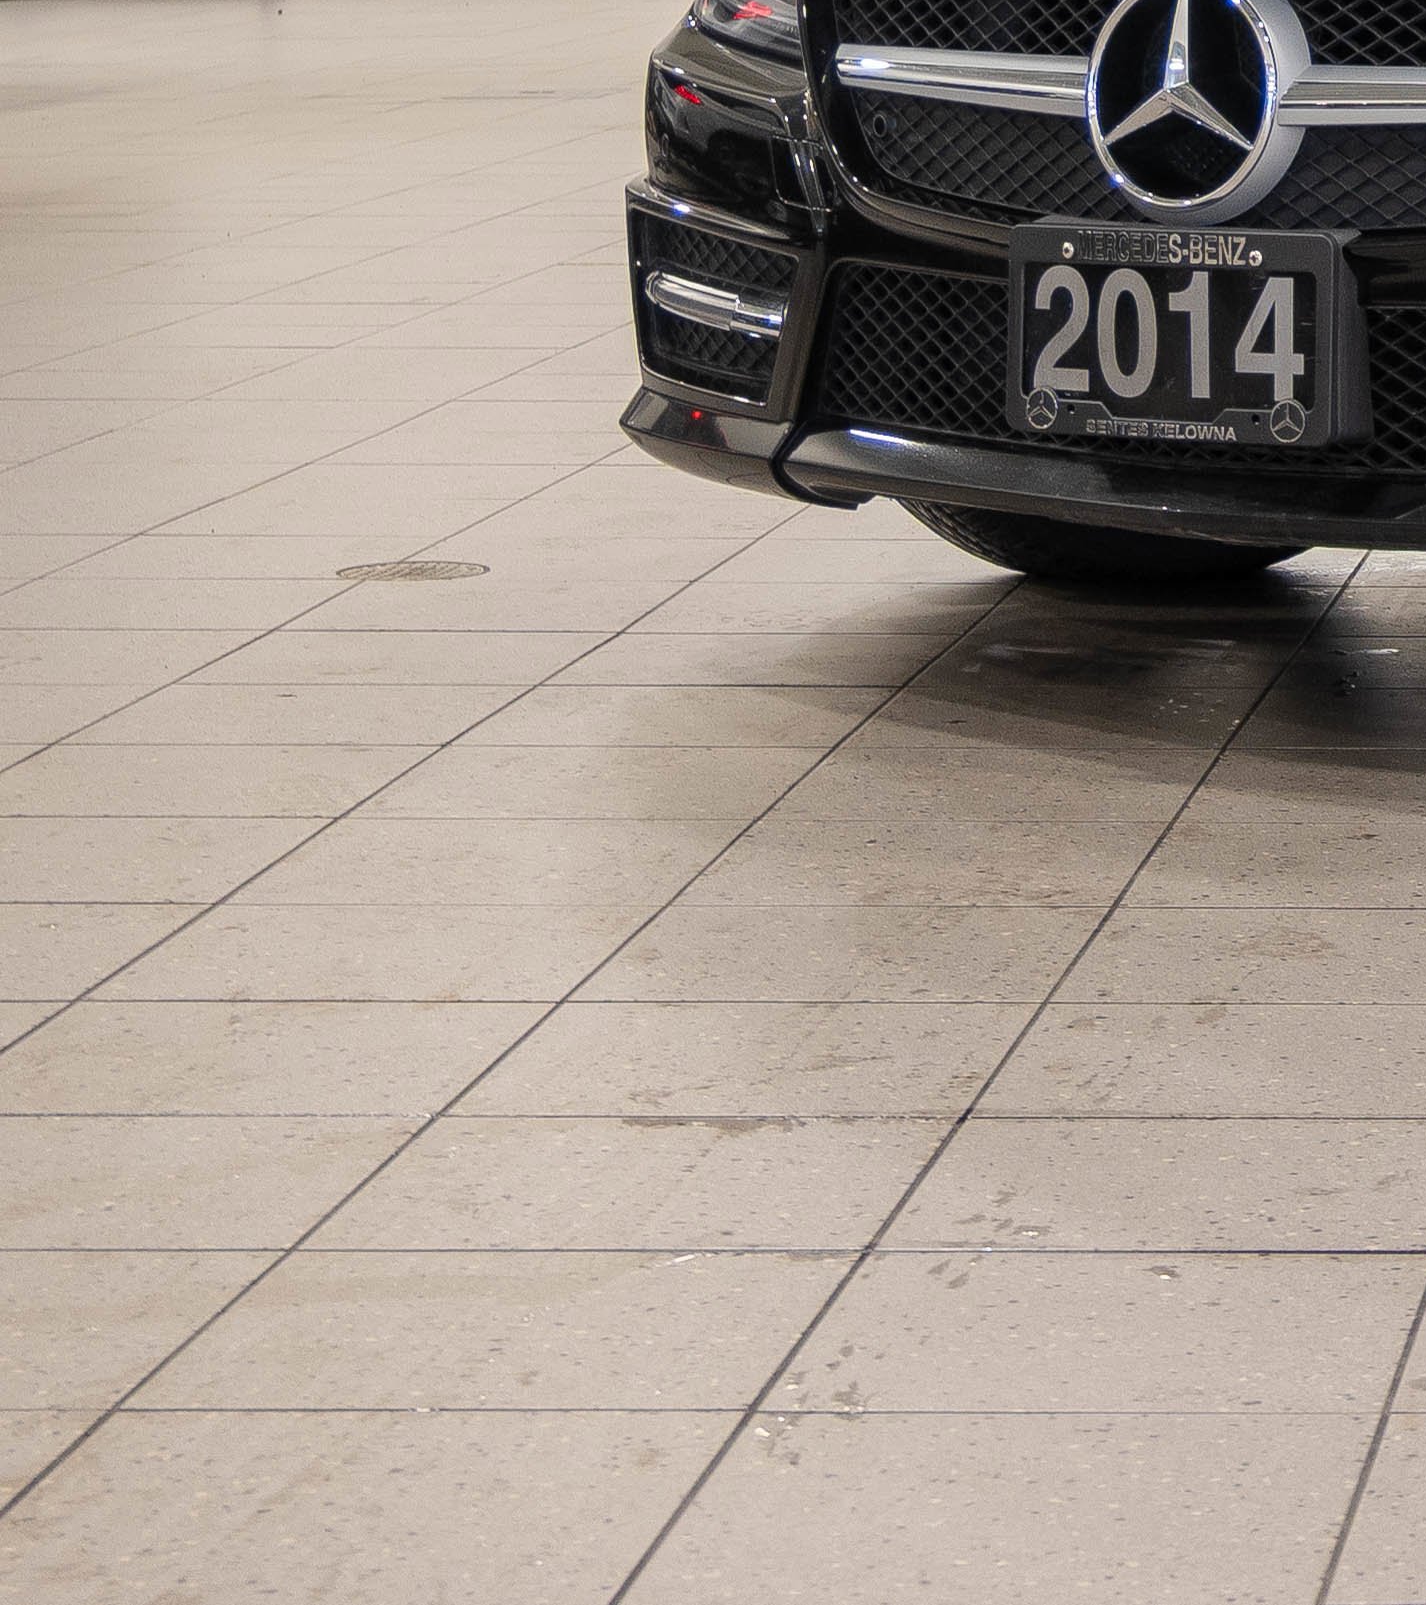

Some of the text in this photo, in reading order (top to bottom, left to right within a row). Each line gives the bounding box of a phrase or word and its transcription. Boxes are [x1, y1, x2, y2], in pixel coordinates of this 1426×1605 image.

[1077, 230, 1247, 267] MERCEDES-BENZ
[1033, 264, 1305, 402] 2014
[1151, 422, 1238, 442] KELOWNA
